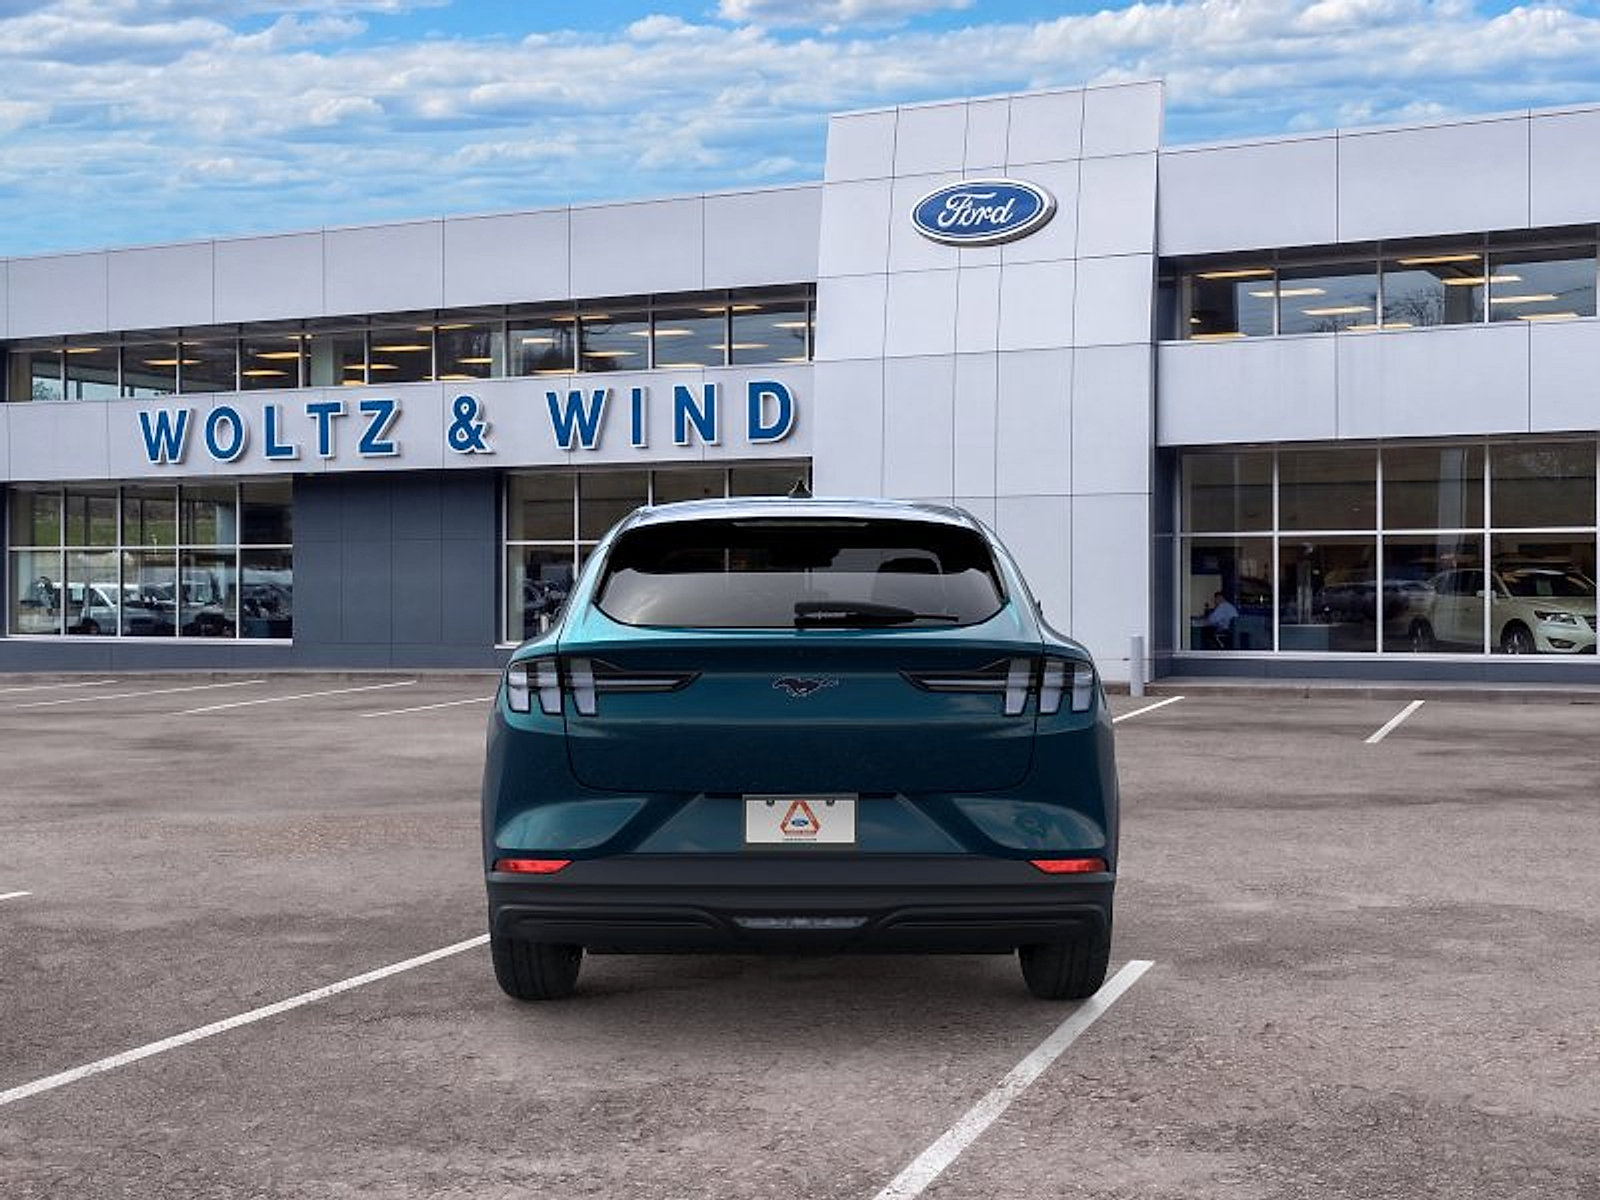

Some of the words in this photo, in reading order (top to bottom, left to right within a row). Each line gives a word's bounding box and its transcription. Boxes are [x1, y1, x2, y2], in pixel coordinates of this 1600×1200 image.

[937, 191, 1016, 228] Ford
[138, 398, 402, 464] WOLTZ
[447, 395, 494, 455] &
[545, 379, 797, 451] WIND
